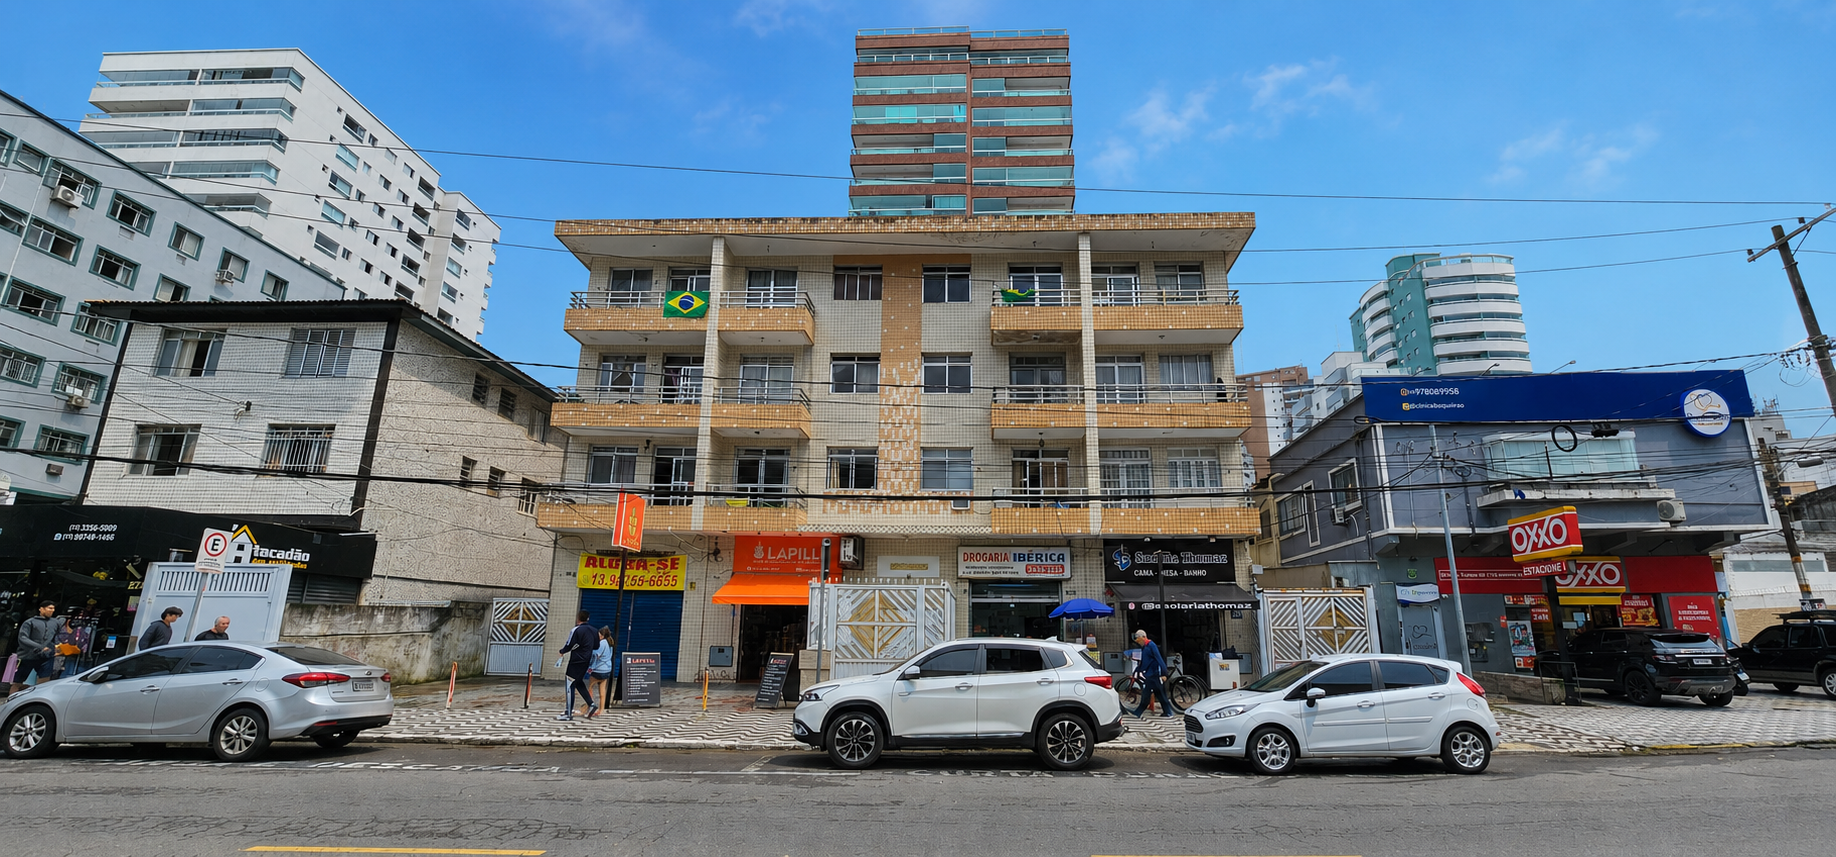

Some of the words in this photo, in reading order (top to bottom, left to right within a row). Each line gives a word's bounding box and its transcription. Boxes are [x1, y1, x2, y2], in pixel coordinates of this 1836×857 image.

[1511, 515, 1568, 554] OXXO
[210, 538, 221, 552] E
[767, 546, 820, 560] LAPILL
[962, 551, 1010, 563] DROGARIA
[1012, 549, 1066, 563] IBÉRICA
[1180, 551, 1228, 564] Thomaz
[1133, 569, 1154, 577] CAMA
[1183, 569, 1207, 577] BANHO
[1523, 561, 1563, 576] ESTACIONE
[906, 769, 1055, 778] CURTA
